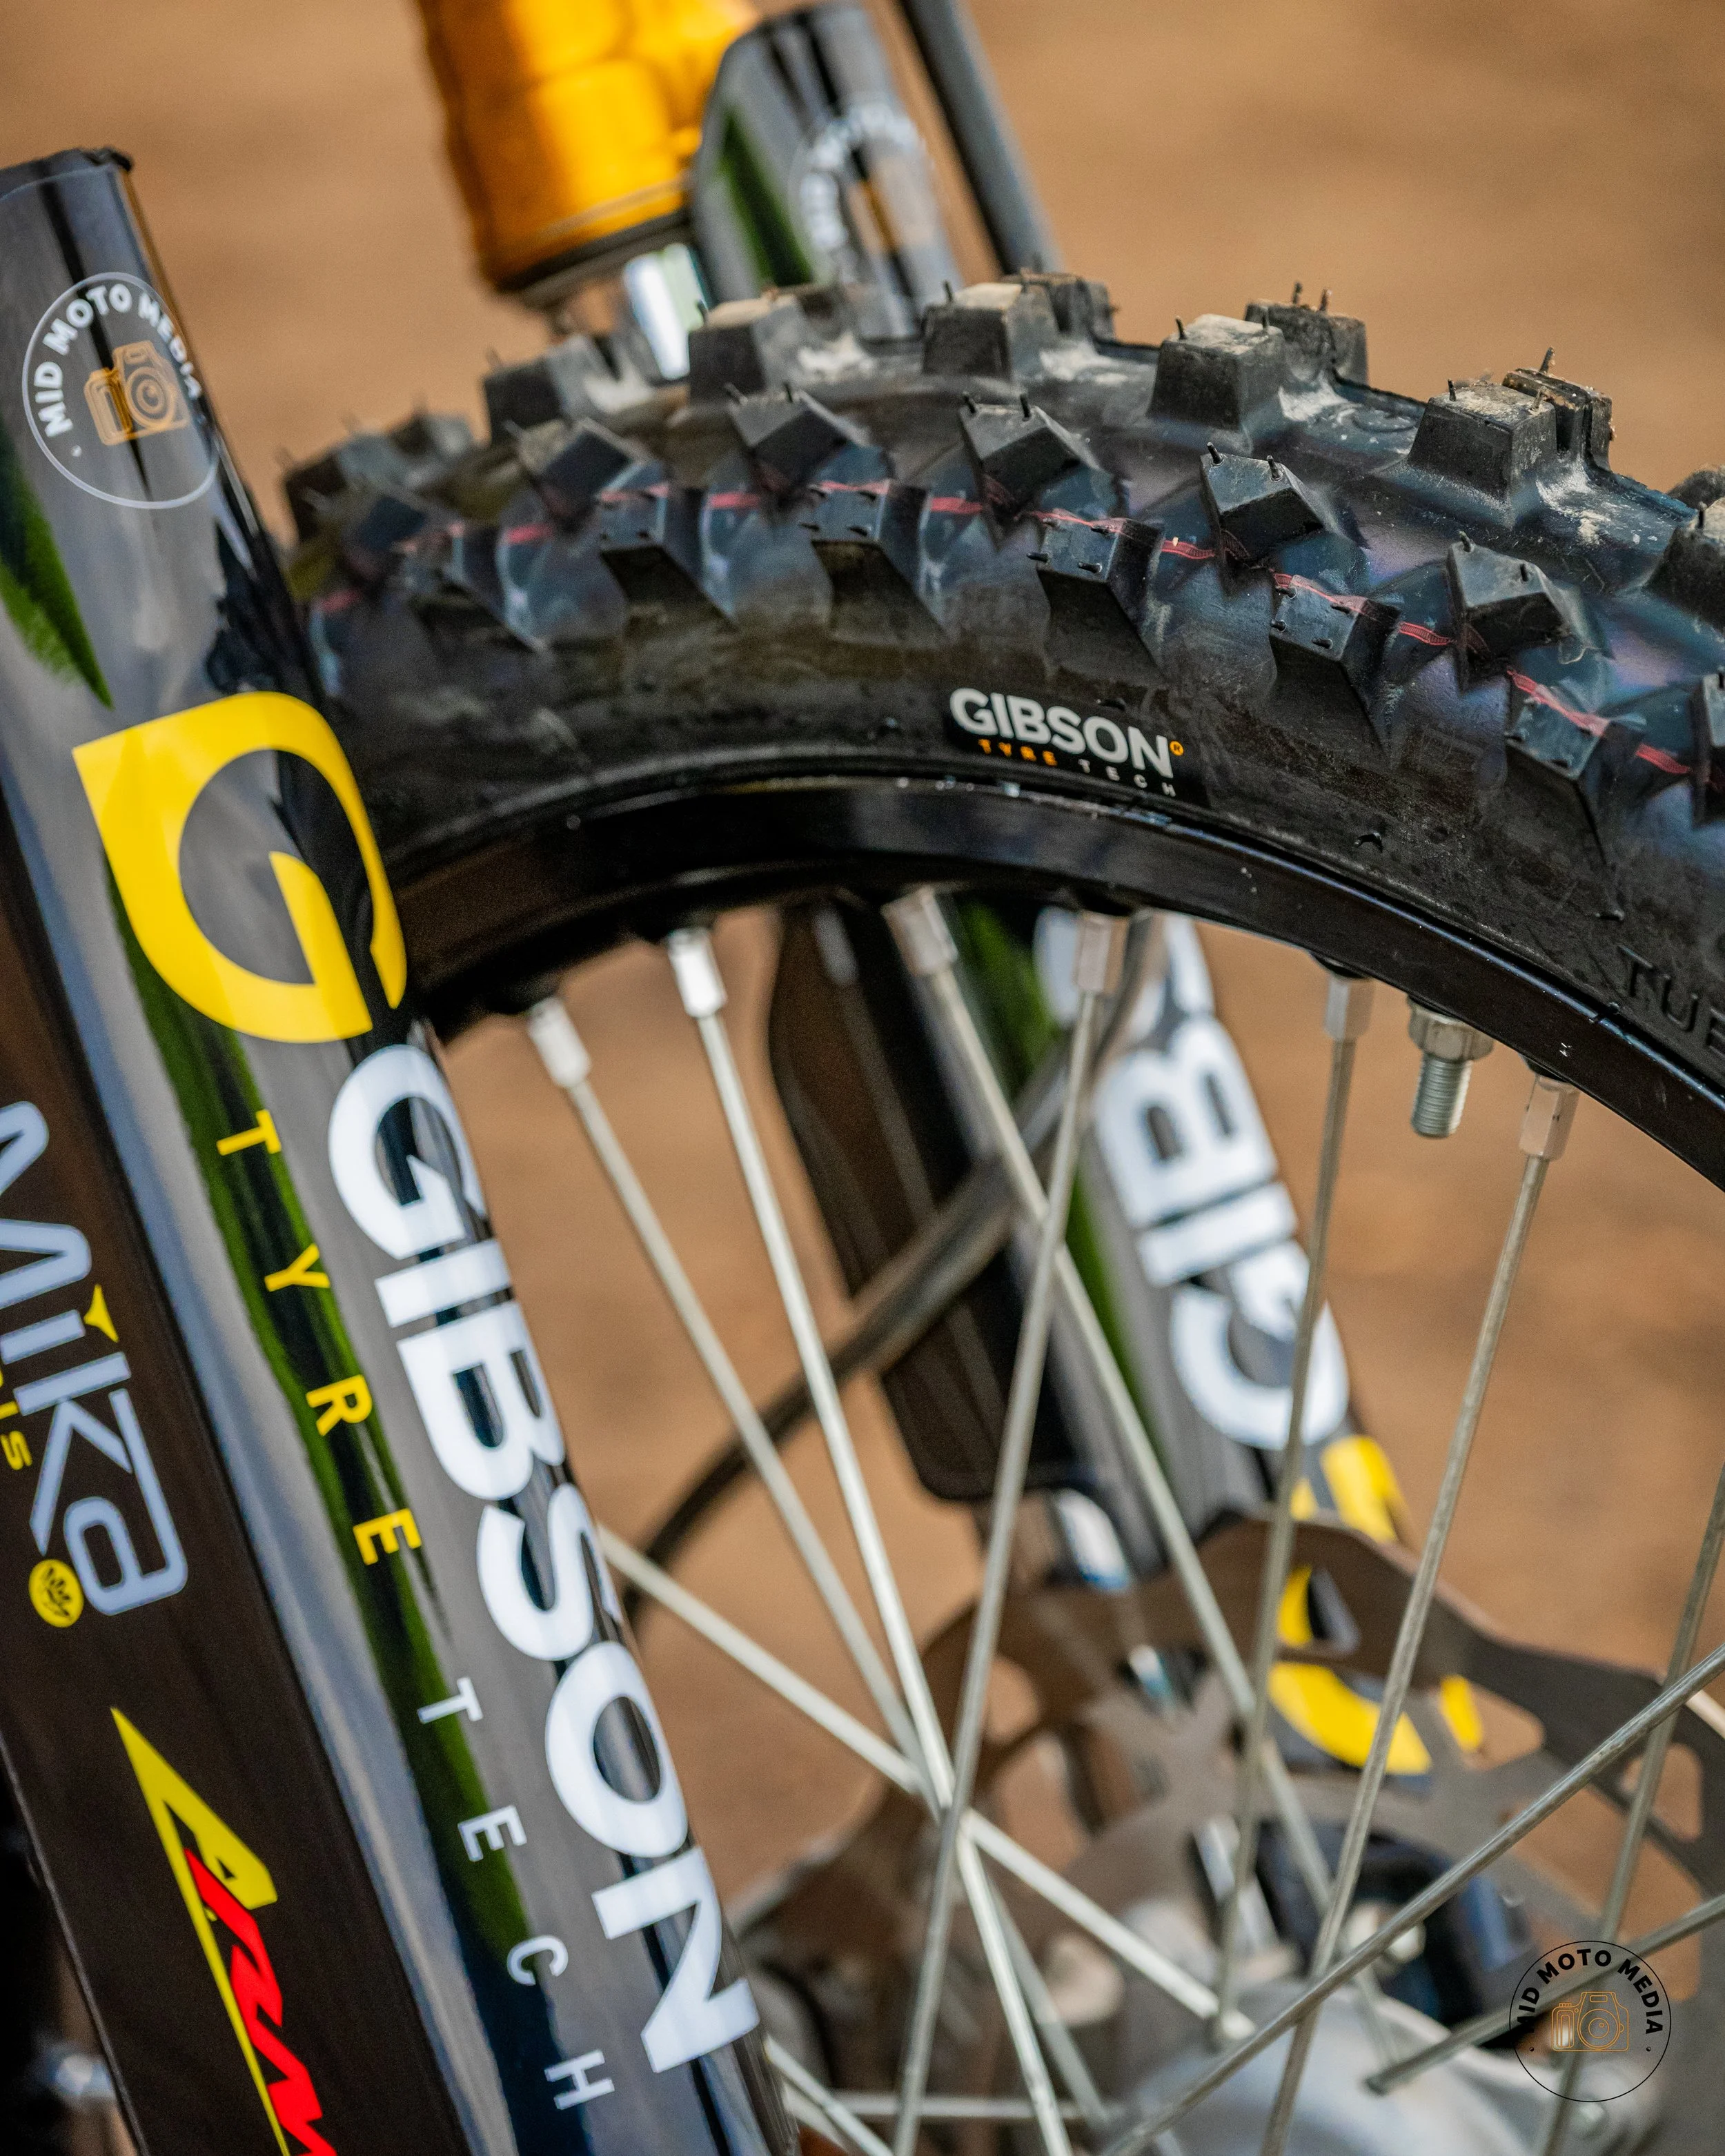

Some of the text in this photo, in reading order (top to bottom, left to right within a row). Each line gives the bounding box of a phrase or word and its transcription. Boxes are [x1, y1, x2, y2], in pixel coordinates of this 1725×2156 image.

[43, 283, 133, 356] MOTO
[34, 361, 73, 437] MID
[949, 687, 1174, 779] GIBSON
[1078, 758, 1176, 798] TECH
[328, 1044, 760, 2074] GIBSON
[216, 1109, 615, 2111] TYRE TECH
